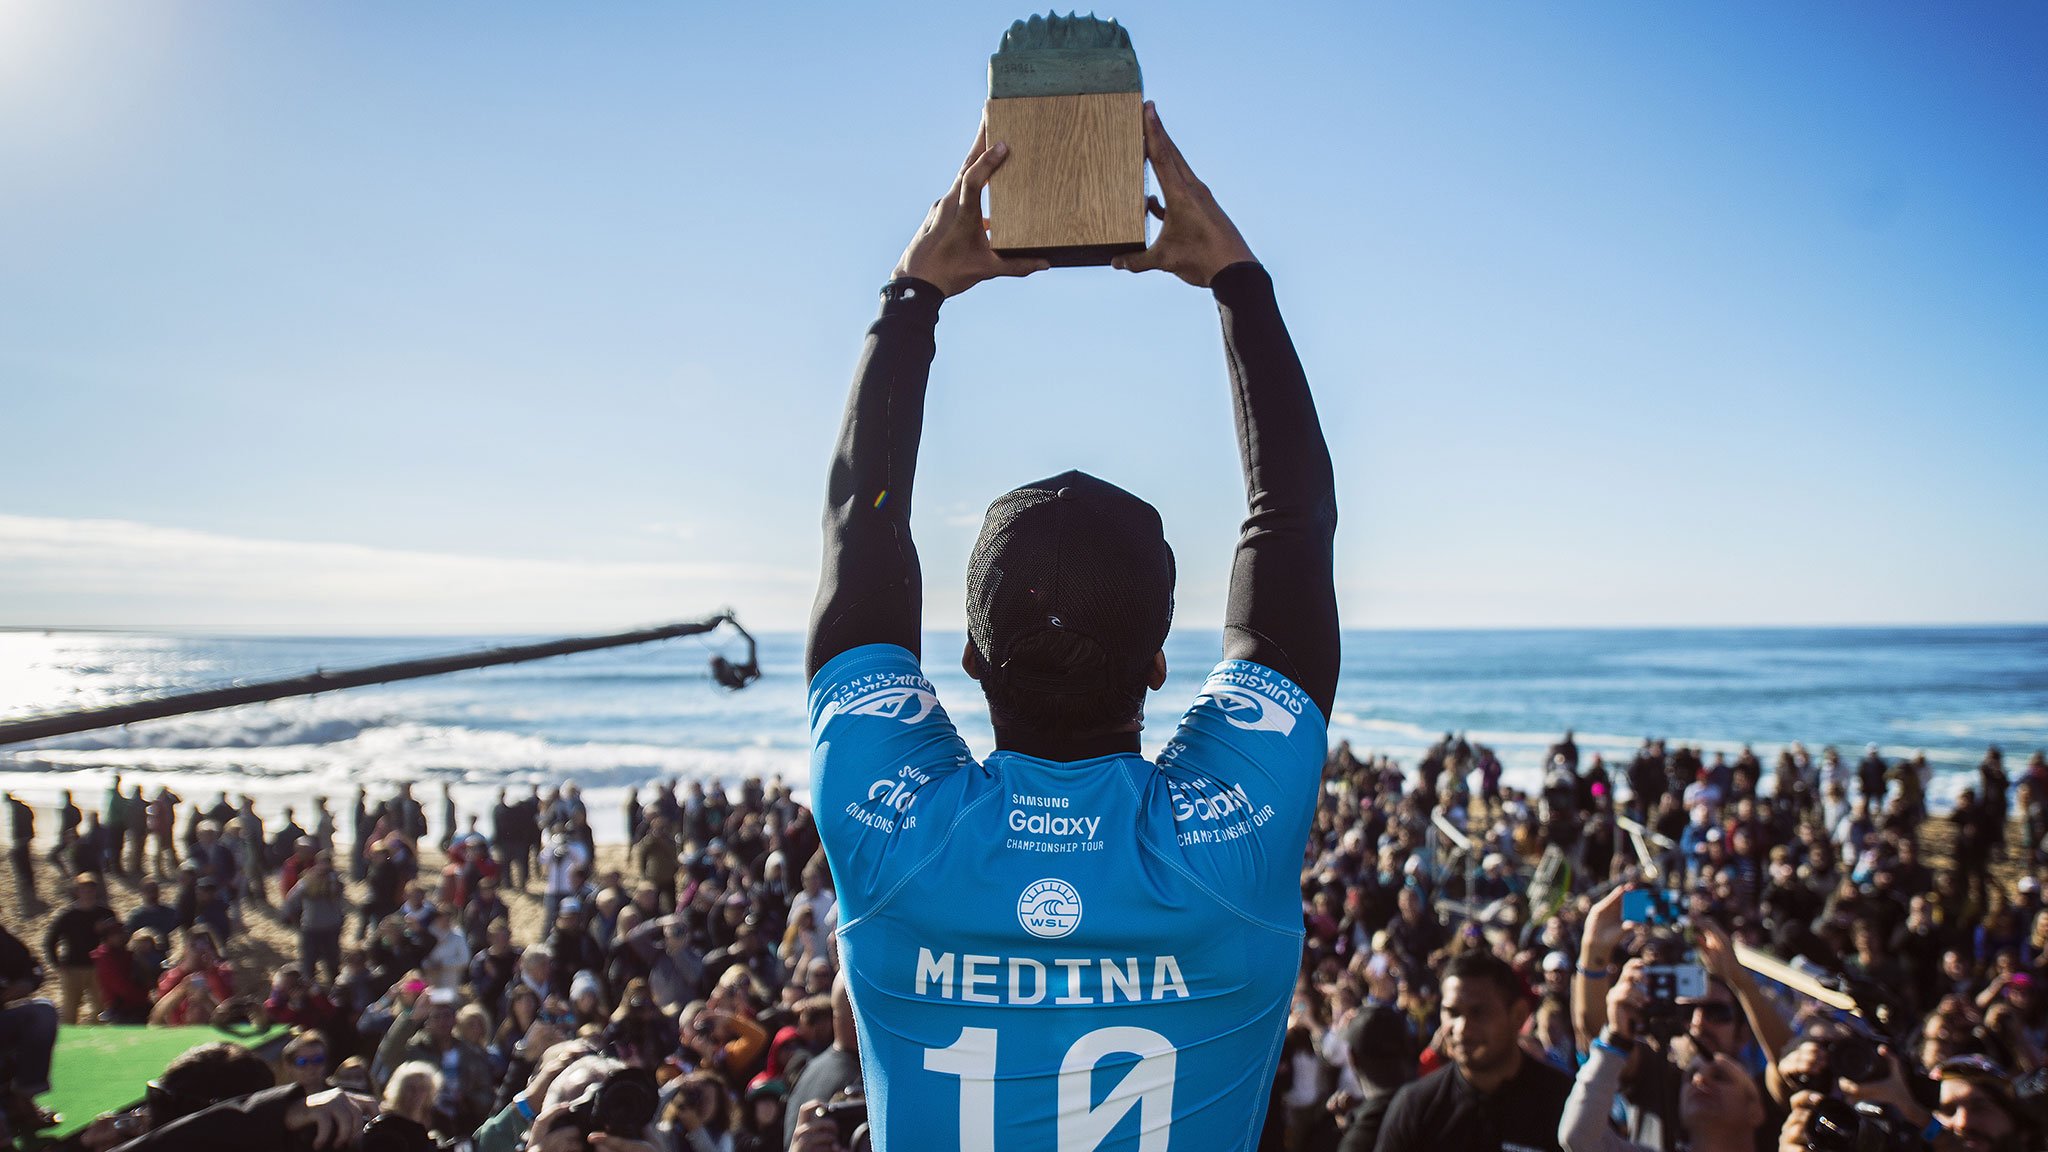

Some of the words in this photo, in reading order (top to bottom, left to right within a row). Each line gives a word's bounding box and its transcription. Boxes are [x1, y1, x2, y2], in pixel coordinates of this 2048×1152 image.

[1280, 679, 1309, 704] PRO
[1012, 793, 1069, 808] SAMSUNG
[1008, 809, 1101, 840] Galaxy
[1252, 804, 1276, 826] OUR
[1006, 838, 1078, 853] CHAMPIONSHIP
[1081, 840, 1104, 851] TOUR
[1030, 918, 1069, 928] WSL
[915, 946, 1190, 1005] MEDINA
[923, 1025, 1178, 1152] 10
